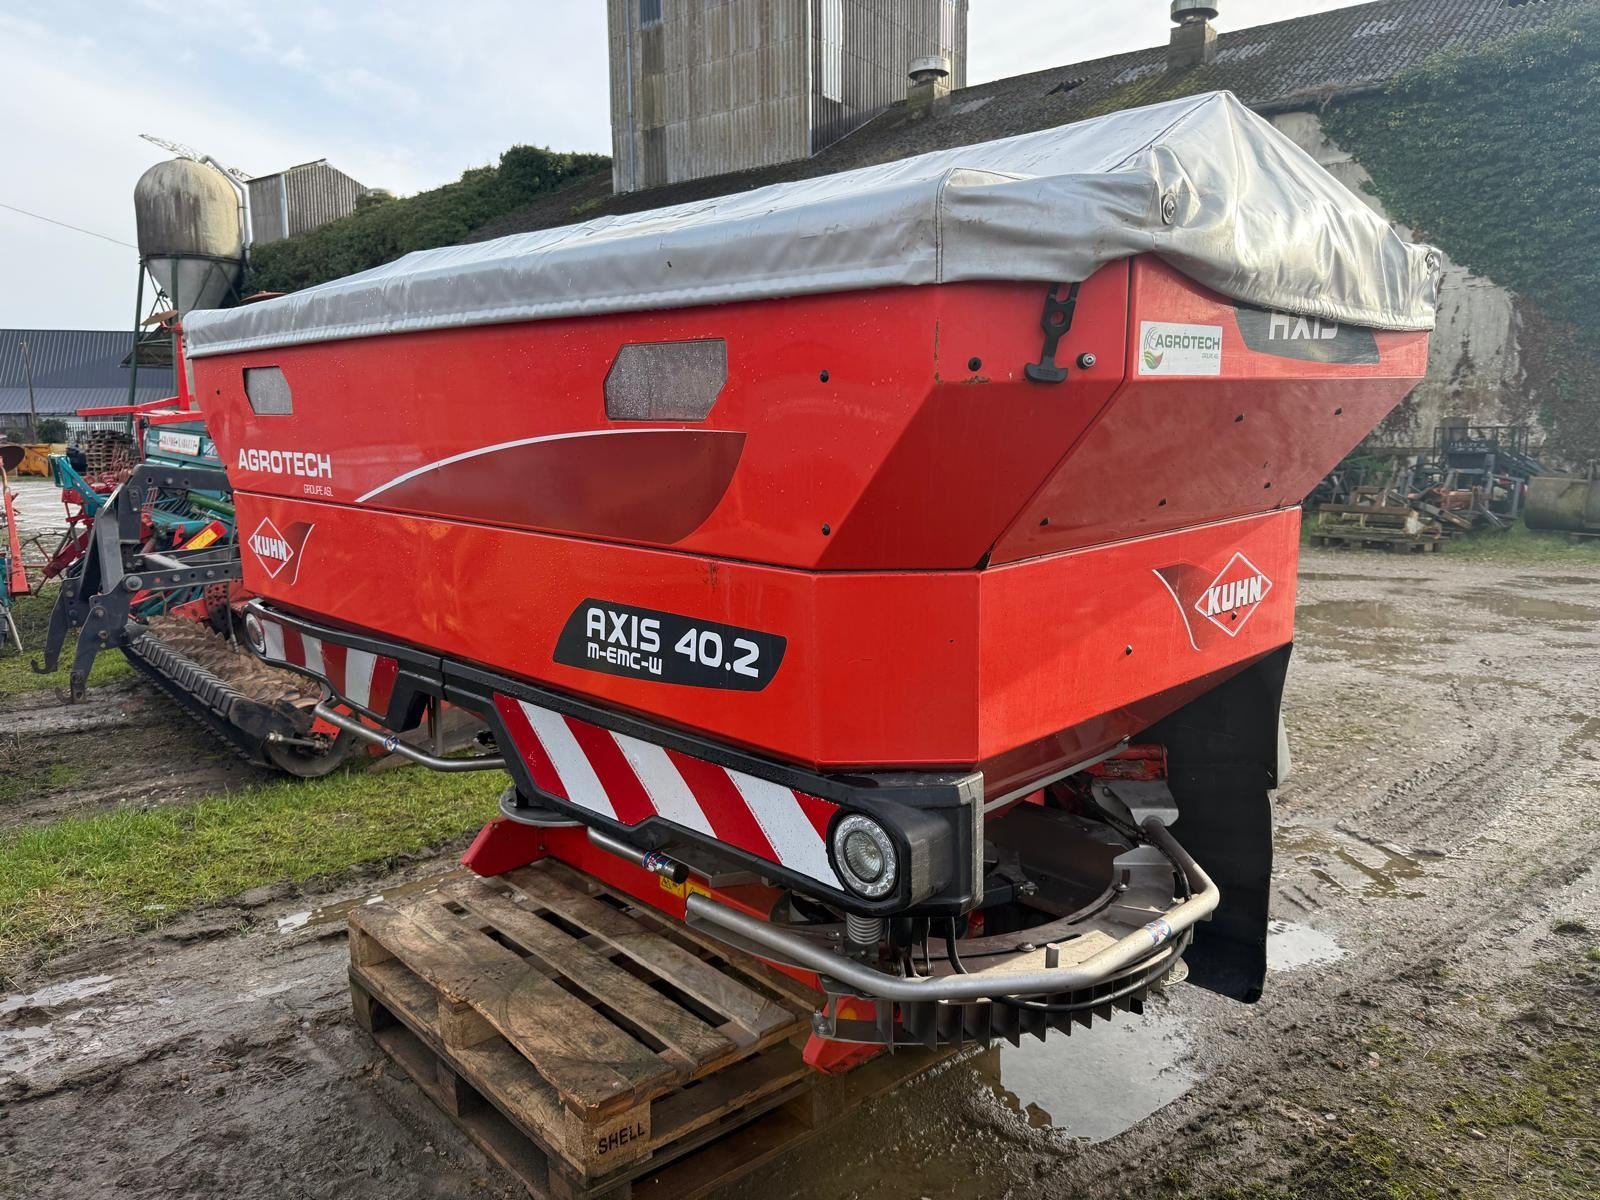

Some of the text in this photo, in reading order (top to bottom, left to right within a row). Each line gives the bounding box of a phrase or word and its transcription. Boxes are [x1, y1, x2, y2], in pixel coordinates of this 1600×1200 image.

[1155, 334, 1220, 351] AGROTECH
[238, 448, 333, 479] AGROTECH
[253, 534, 288, 562] KUHN
[1207, 575, 1262, 617] KUHN
[586, 607, 760, 679] AXIS 40.2
[598, 1122, 645, 1154] SHELL
